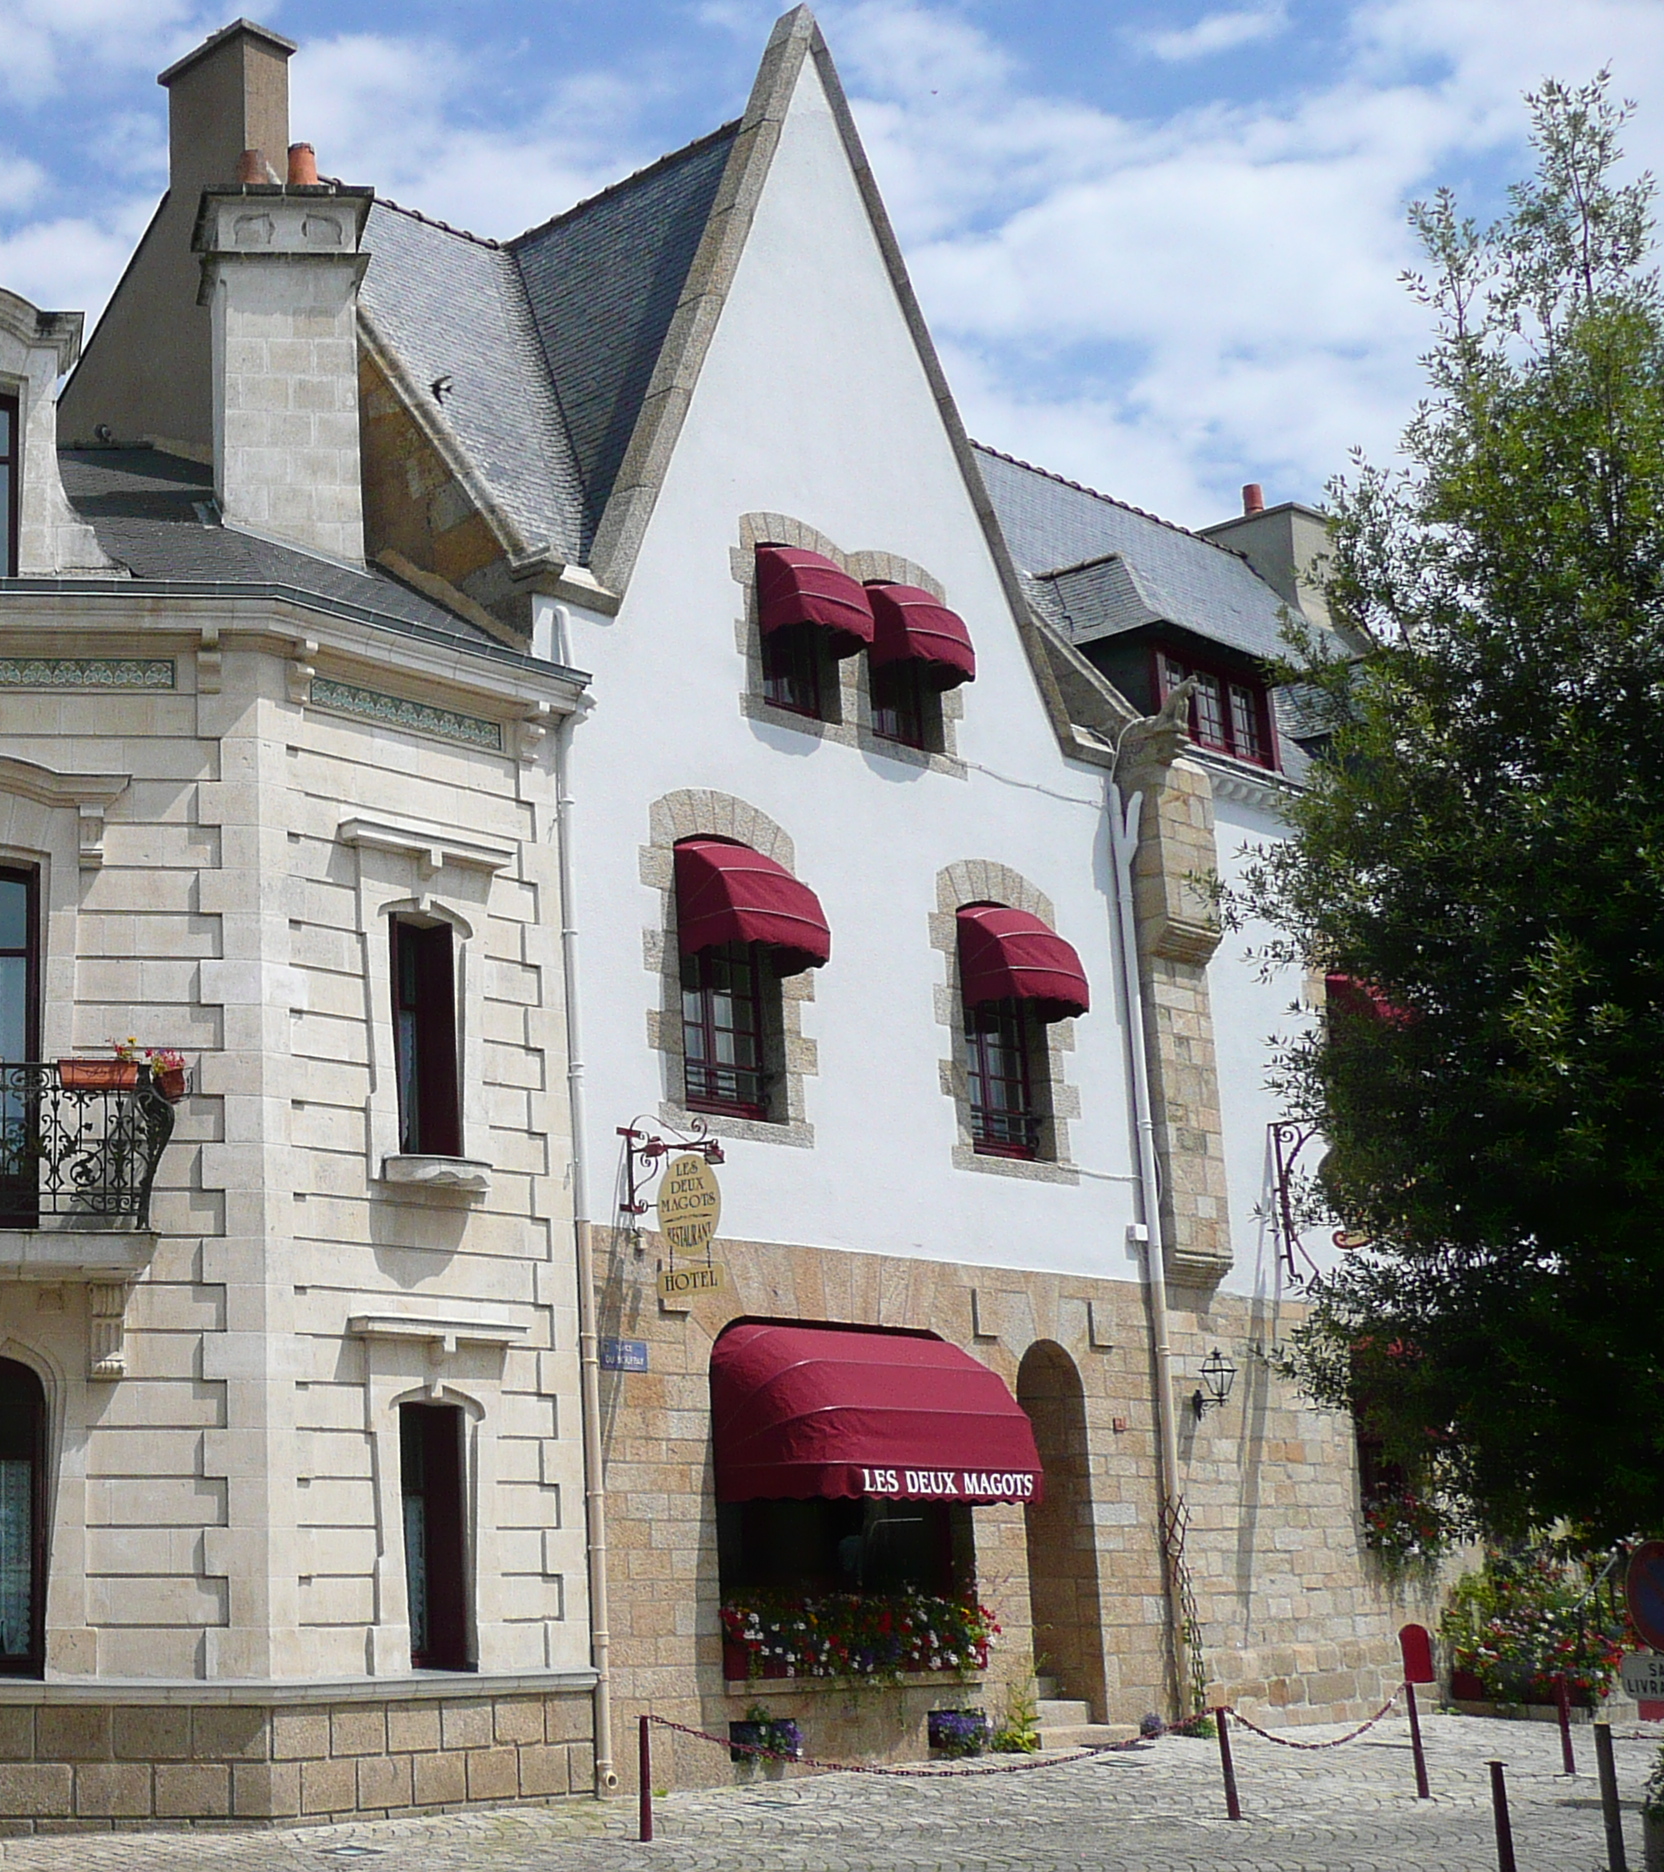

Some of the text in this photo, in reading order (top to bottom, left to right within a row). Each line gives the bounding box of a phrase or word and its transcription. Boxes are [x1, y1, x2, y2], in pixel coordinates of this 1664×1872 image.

[675, 1160, 698, 1177] LES
[670, 1177, 705, 1195] DEUX
[660, 1191, 716, 1213] MAGOTS
[667, 1221, 712, 1248] RESTAURANT
[664, 1270, 718, 1292] HOTEL
[862, 1468, 1034, 1497] LES DEUX MAGOTS
